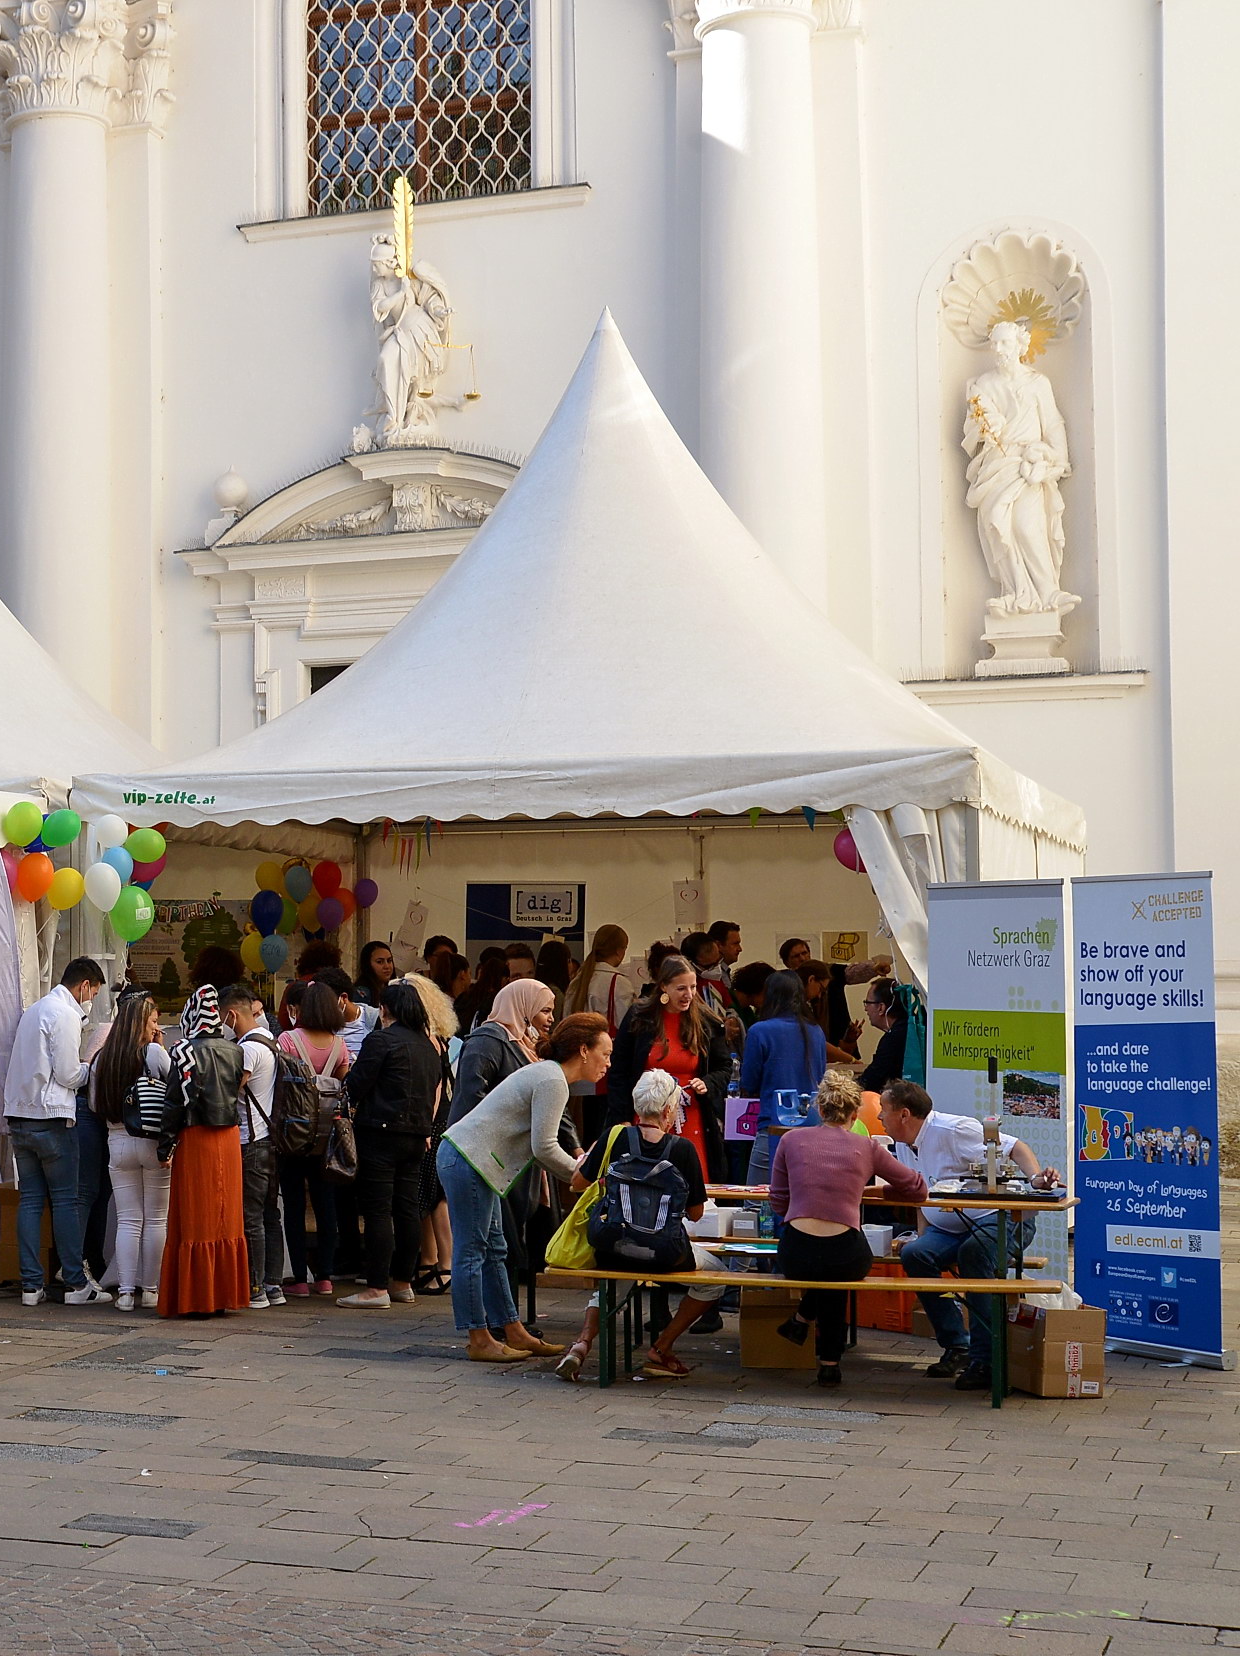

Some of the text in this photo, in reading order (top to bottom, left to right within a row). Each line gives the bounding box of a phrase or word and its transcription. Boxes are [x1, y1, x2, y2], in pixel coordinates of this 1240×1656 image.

[123, 789, 216, 806] vip-zelte.at
[1148, 890, 1204, 907] CHALLENGE
[1152, 906, 1202, 922] ACCEPTED
[993, 926, 1050, 949] Sprachen
[1080, 940, 1186, 959] Be brave and
[967, 950, 1051, 968] Netzwerk Graz
[1080, 964, 1184, 986] show off your
[1080, 988, 1204, 1011] language skills!
[963, 1021, 1000, 1038] fördern
[1087, 1042, 1150, 1056] ...and dare
[1087, 1059, 1149, 1073] to take the
[1087, 1077, 1211, 1094] language challenge!
[1085, 1177, 1208, 1200] European Day of Languages
[1106, 1197, 1187, 1219] 26 September
[1114, 1233, 1183, 1250] edl.ecml.at
